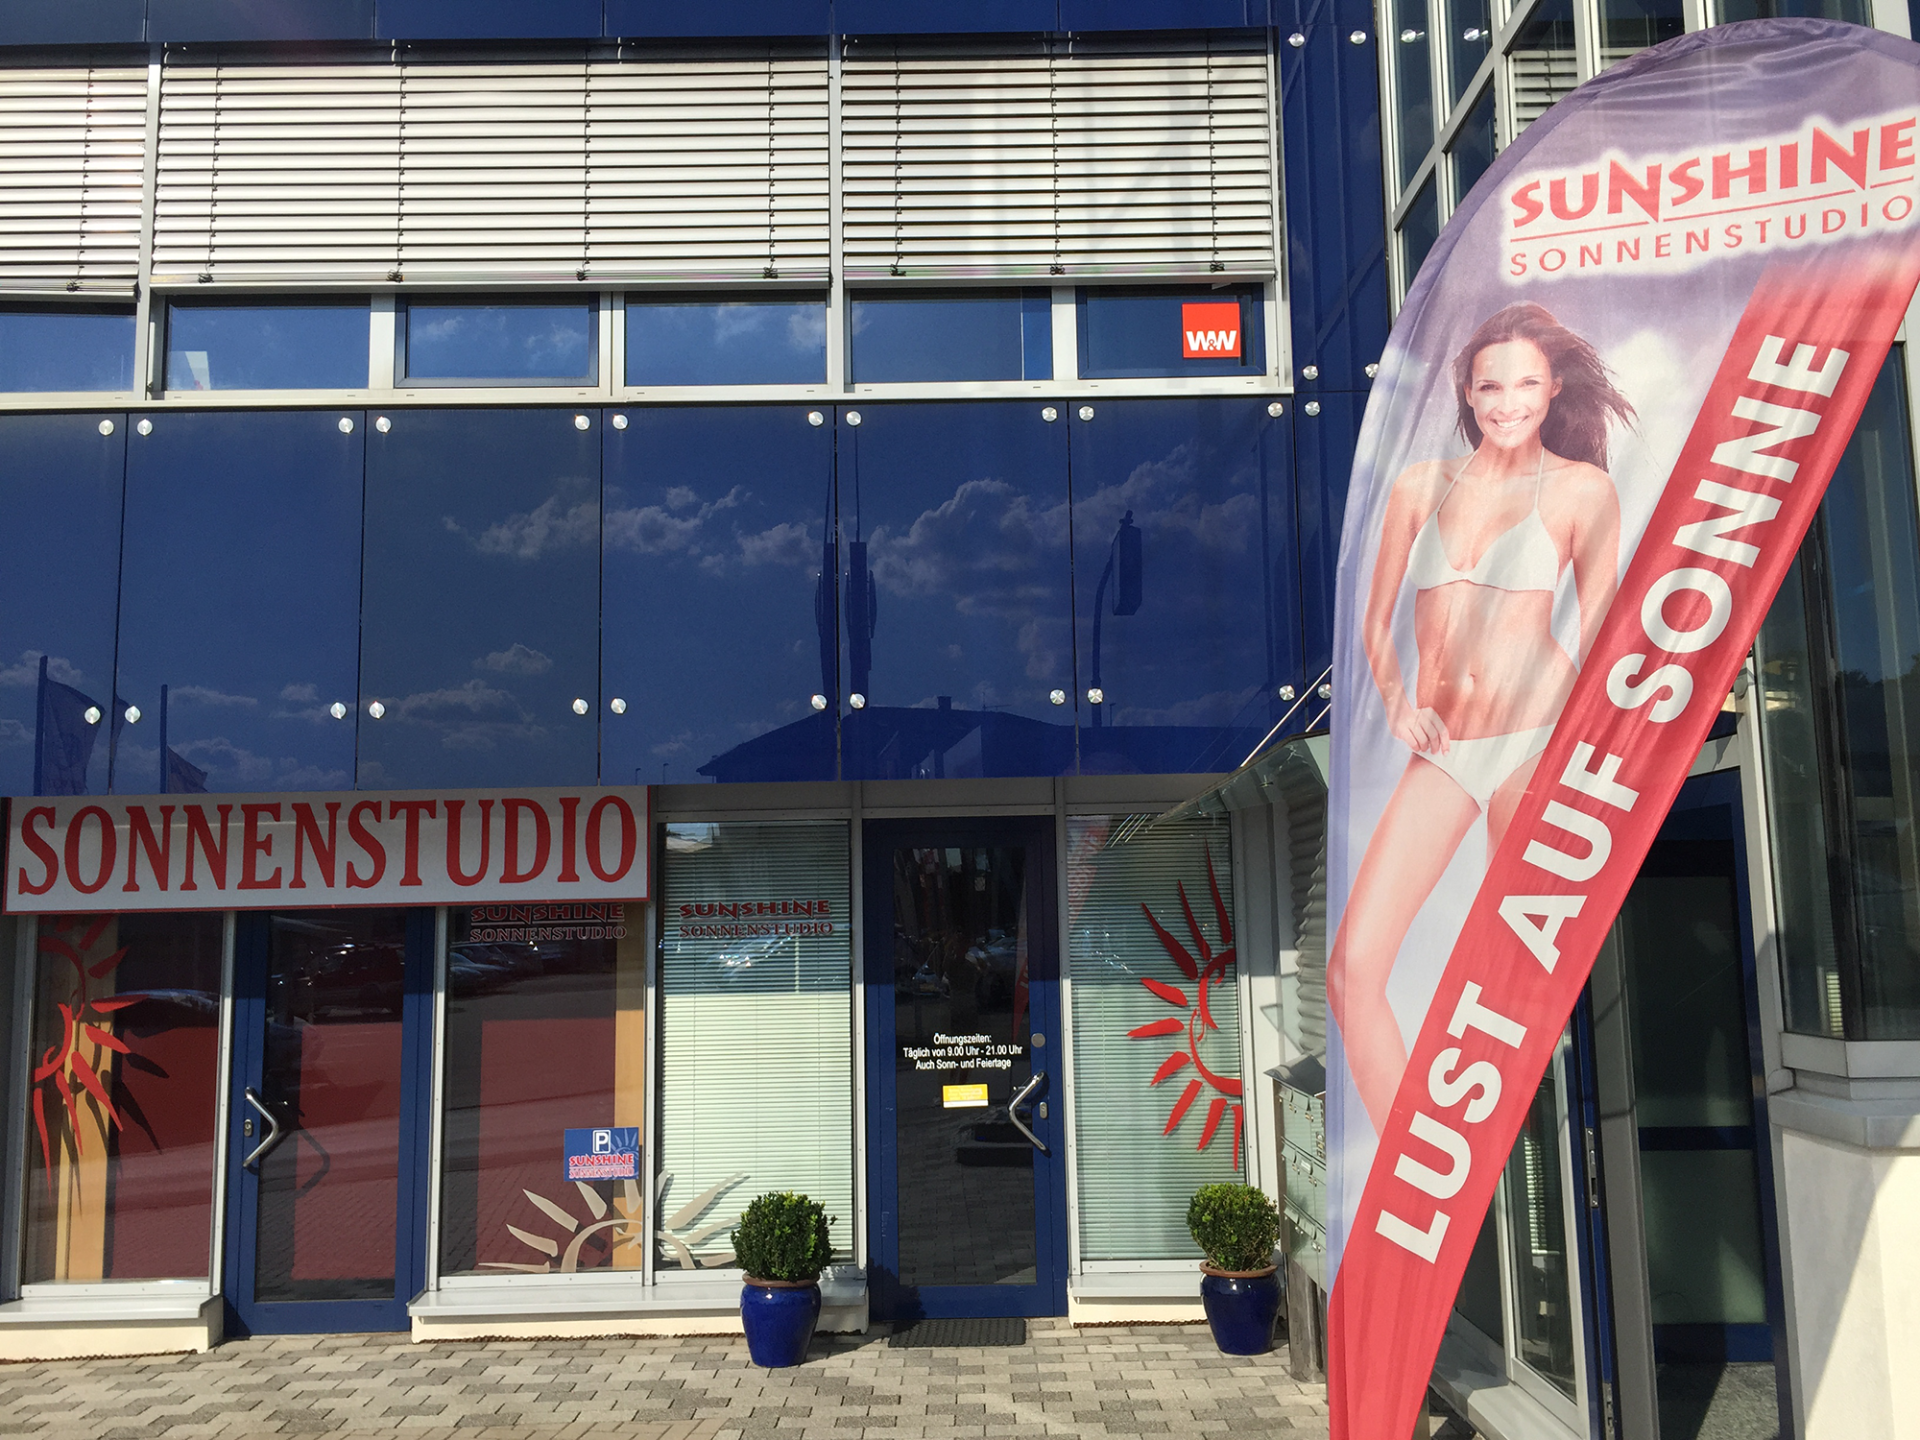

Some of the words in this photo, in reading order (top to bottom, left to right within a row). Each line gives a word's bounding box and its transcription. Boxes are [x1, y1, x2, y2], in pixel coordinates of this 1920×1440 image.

[1510, 117, 1917, 228] SUNSHINE
[1510, 195, 1914, 276] SONNENSTUDIO
[1185, 329, 1237, 352] W&W
[1375, 980, 1528, 1265] LUST
[1498, 740, 1640, 975] AUF
[1606, 334, 1851, 723] SONNE
[18, 795, 637, 895] SONNENSTUDIO
[471, 903, 625, 924] SUNSHINE
[679, 899, 831, 919] SUNSHINE
[470, 925, 627, 942] SONNENSTUDIO
[679, 922, 833, 938] SONNENSTUDIO
[933, 1032, 992, 1045] Öffnungszeiten:
[903, 1047, 930, 1060] Täglich
[931, 1048, 946, 1057] von
[947, 1046, 964, 1056] 9.00
[965, 1046, 980, 1056] Uhr
[985, 1045, 1007, 1056] 21.00
[1008, 1045, 1023, 1055] Uhr
[915, 1060, 935, 1070] Auch
[936, 1059, 959, 1069] Sonn-
[960, 1059, 975, 1069] und
[976, 1058, 1012, 1070] Feiertage
[595, 1131, 609, 1152] P
[569, 1152, 634, 1167] SUNSHINE
